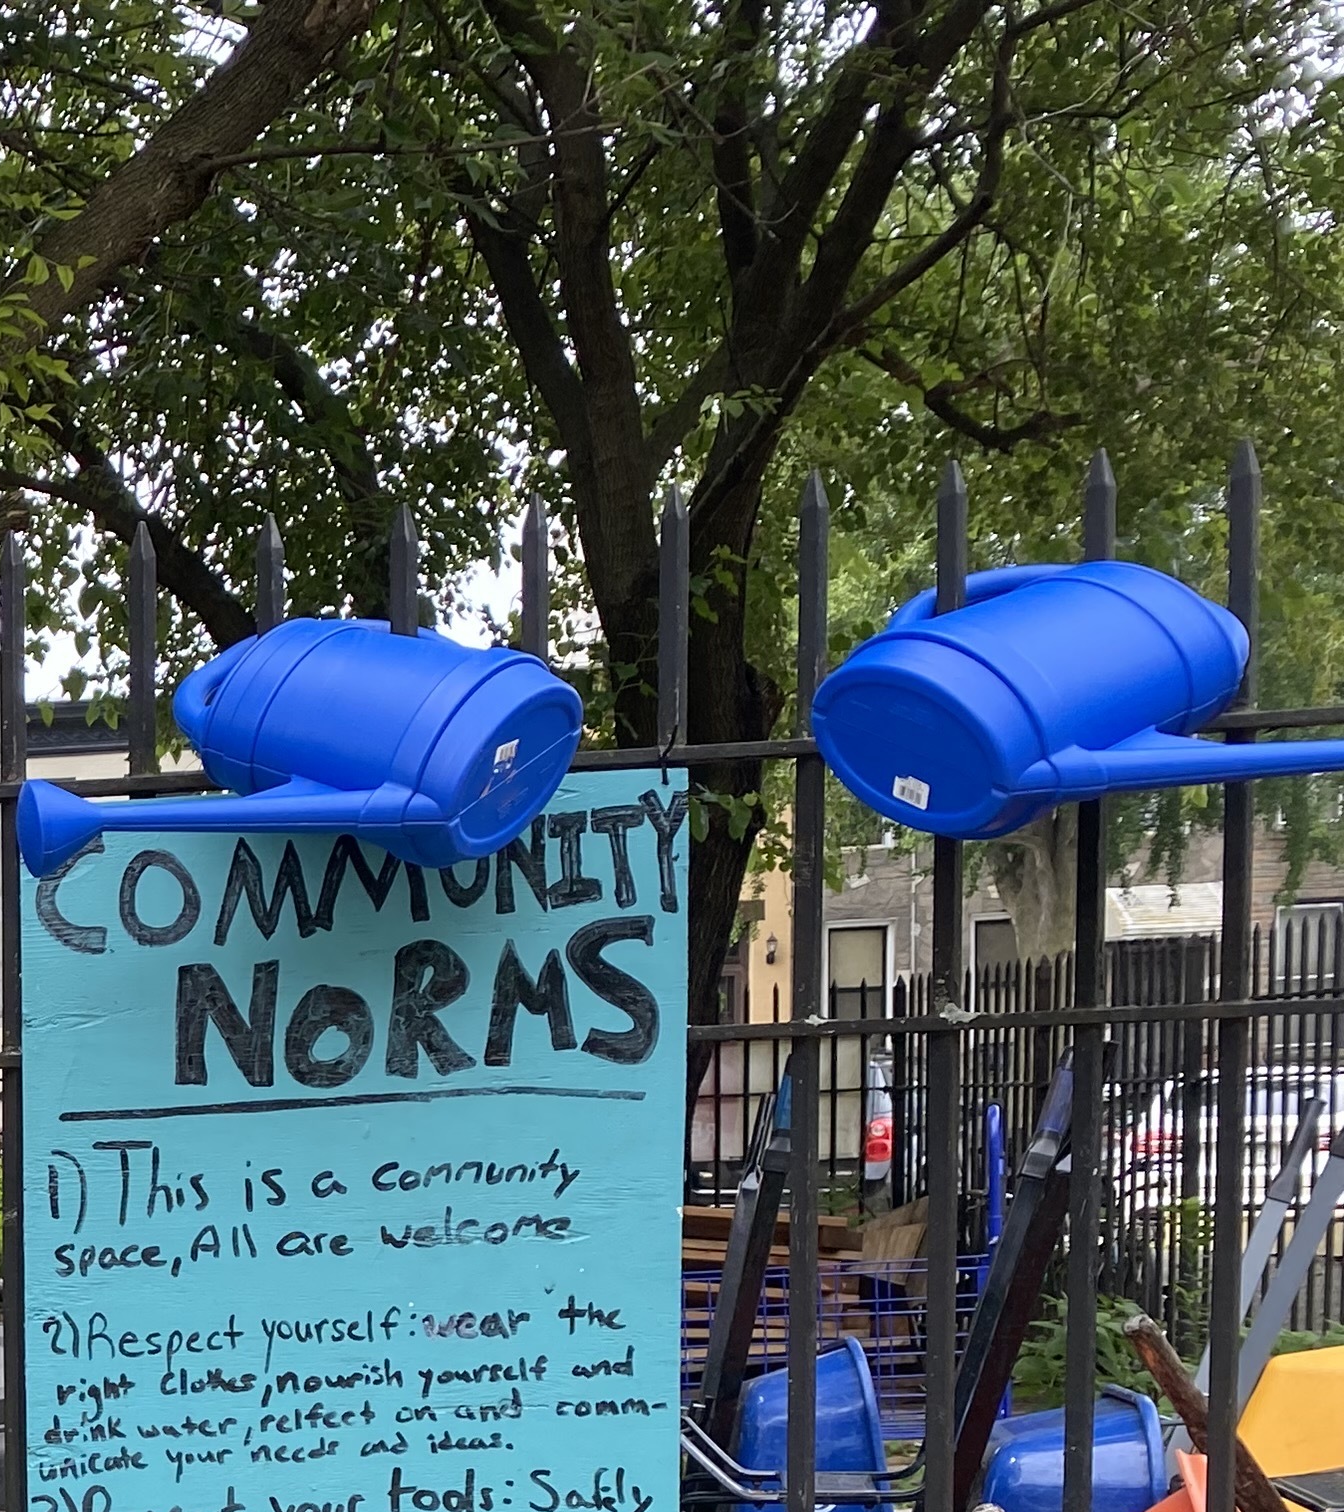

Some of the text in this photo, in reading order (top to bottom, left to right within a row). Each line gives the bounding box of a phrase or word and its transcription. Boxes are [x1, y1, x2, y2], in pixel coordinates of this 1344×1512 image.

[36, 788, 687, 953] COMMUNITY
[175, 914, 662, 1089] NORMS
[245, 1161, 287, 1213] is
[312, 1171, 348, 1198] a
[191, 1223, 258, 1262] All
[276, 1231, 354, 1257] are
[381, 1206, 572, 1249] welcome
[422, 1308, 531, 1340] wear
[558, 1295, 627, 1335] the
[57, 1373, 136, 1426] right
[418, 1354, 549, 1398] yourself
[571, 1345, 635, 1379] and
[43, 1415, 127, 1445] drink
[395, 1404, 438, 1423] on
[455, 1387, 523, 1422] and
[39, 1430, 515, 1483] unicate your needs and ideas.
